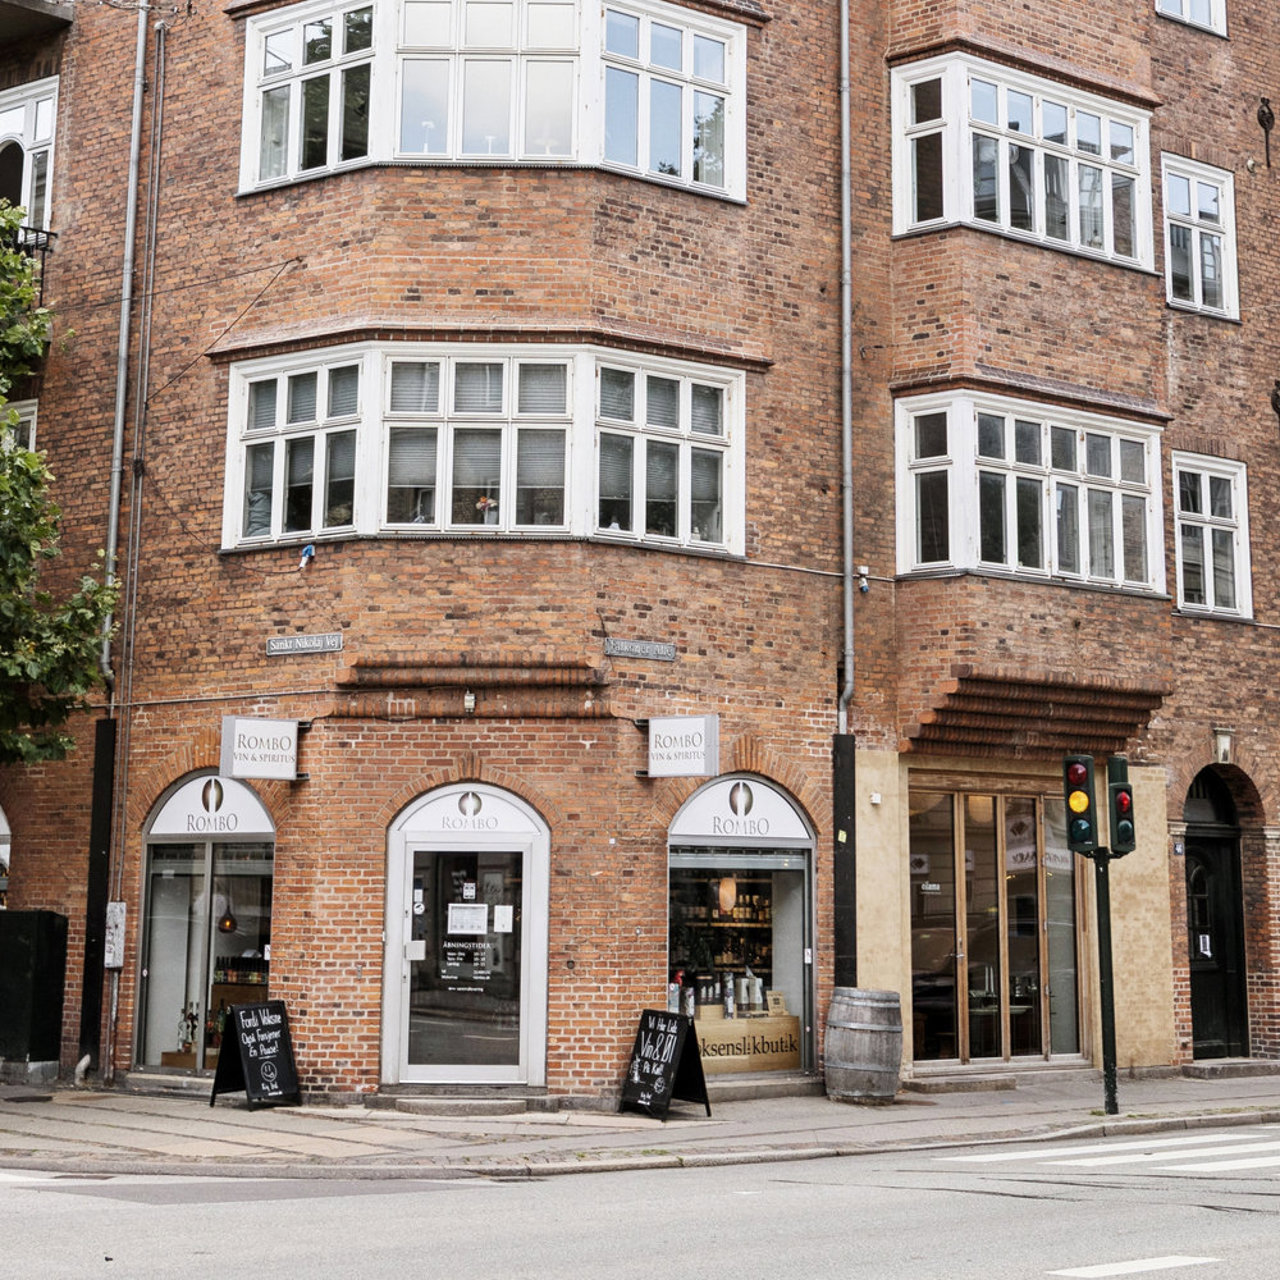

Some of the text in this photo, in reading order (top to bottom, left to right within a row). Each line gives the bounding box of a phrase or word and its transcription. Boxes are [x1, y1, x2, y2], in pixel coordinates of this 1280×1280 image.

[270, 635, 338, 651] Sankt Nikolaj Vej
[237, 733, 292, 751] ROMBO
[654, 731, 702, 749] ROMBO
[233, 752, 249, 761] VIN
[259, 754, 296, 763] SPIRITUS
[650, 751, 706, 761] VIN & SPIRITUS
[187, 813, 238, 831] ROMBO
[442, 816, 499, 830] ROMBO
[713, 816, 769, 835] ROMBO
[652, 1033, 665, 1060] &
[699, 1033, 798, 1057] ksenslikbutik
